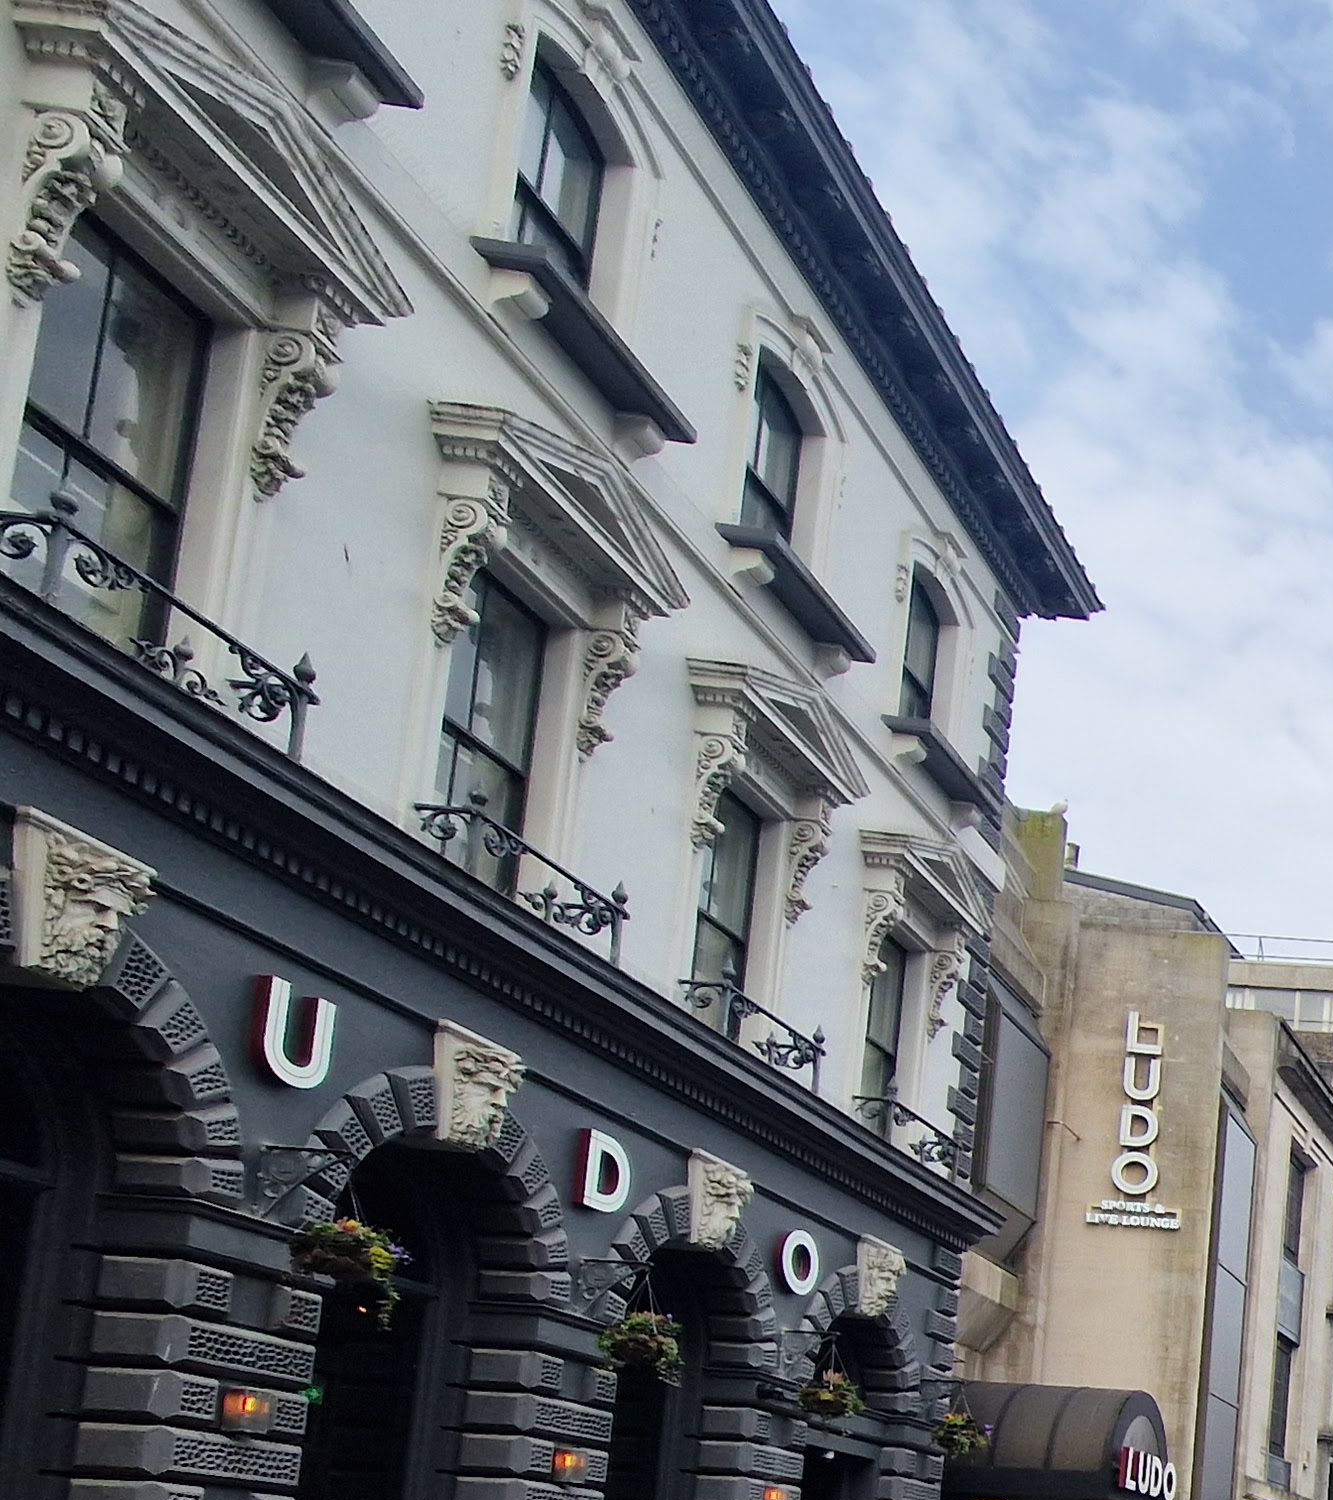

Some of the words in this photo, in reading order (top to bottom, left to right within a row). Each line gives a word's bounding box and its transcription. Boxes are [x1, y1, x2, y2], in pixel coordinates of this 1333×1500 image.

[1111, 1011, 1163, 1195] LUDO
[1101, 1199, 1149, 1214] SPORTS
[1154, 1203, 1165, 1214] &
[1086, 1212, 1119, 1224] LIVE
[1122, 1214, 1180, 1229] LOUNGE
